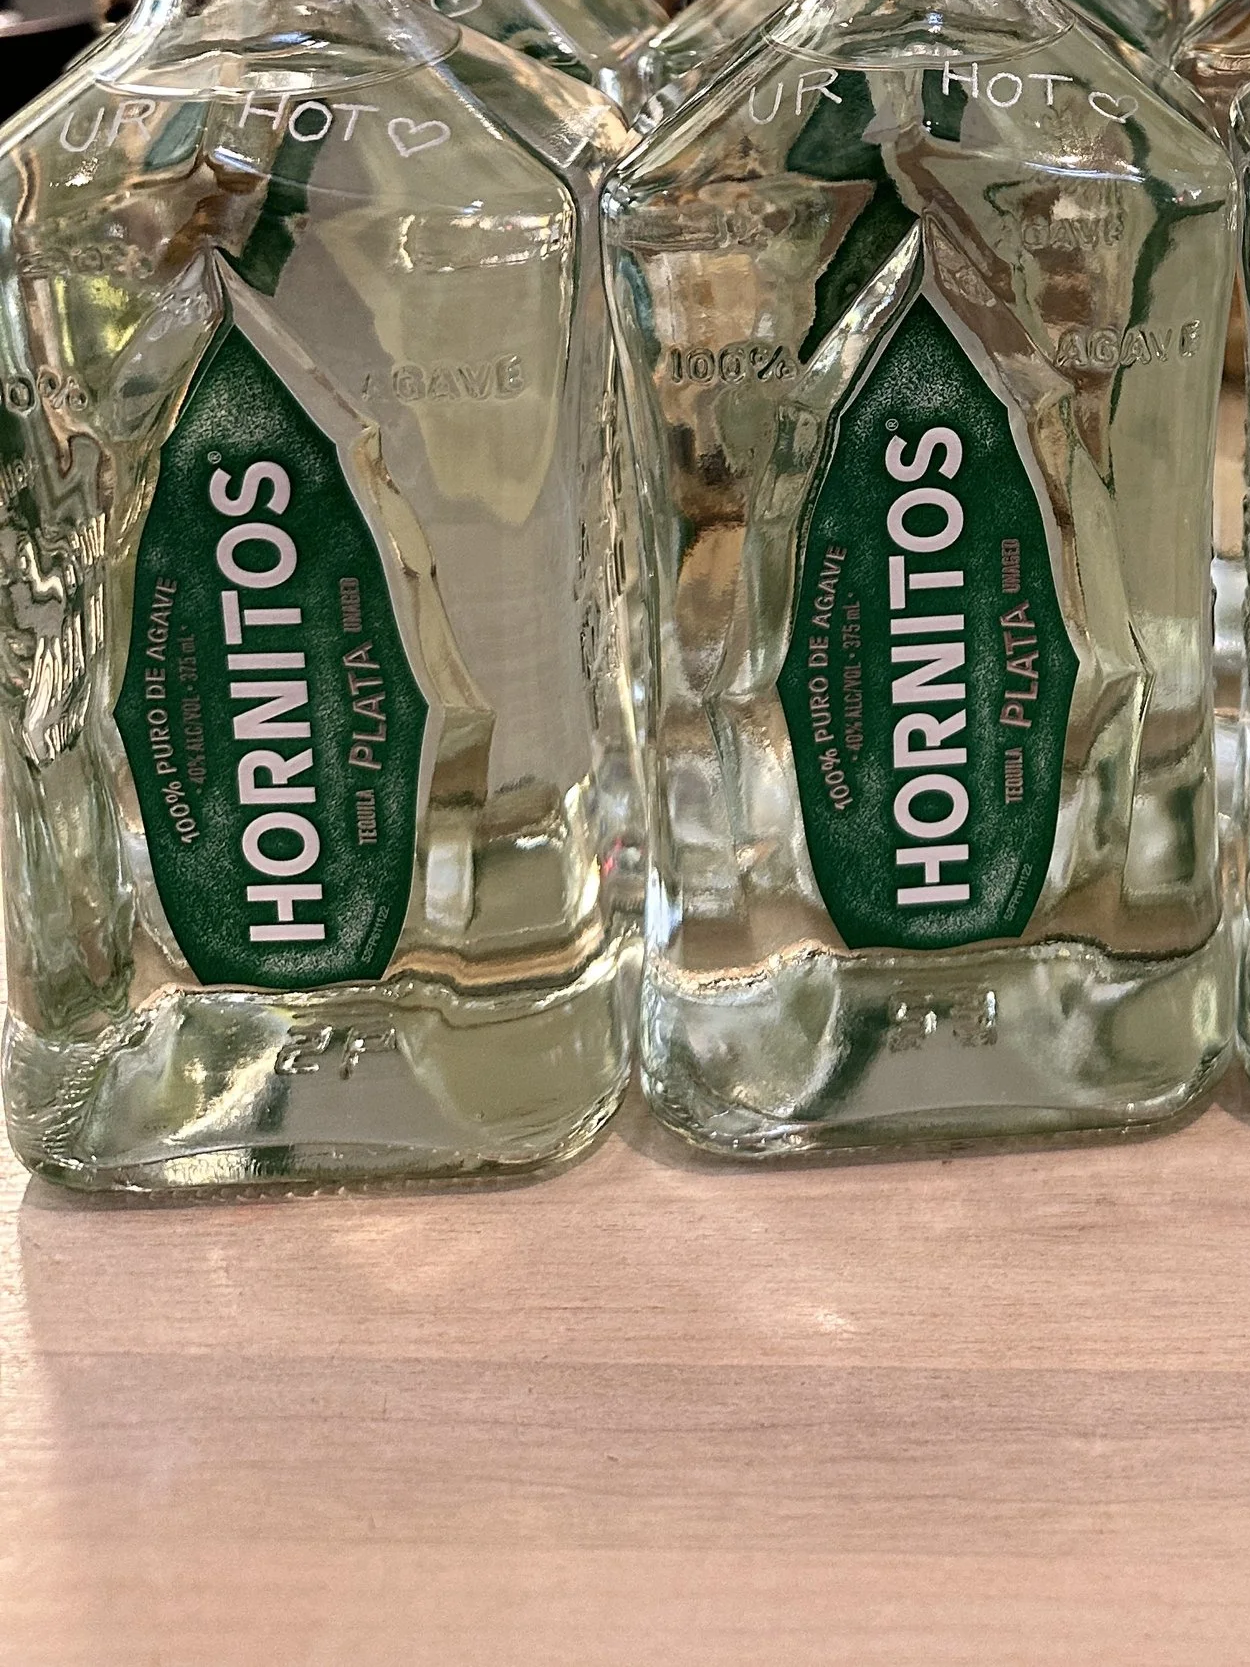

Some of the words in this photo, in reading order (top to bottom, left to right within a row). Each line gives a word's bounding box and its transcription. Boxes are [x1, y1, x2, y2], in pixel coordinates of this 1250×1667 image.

[60, 97, 155, 153] UR
[238, 91, 379, 142] HOT
[748, 68, 842, 126] UR
[942, 60, 1073, 108] HOT
[669, 345, 798, 384] 100%
[811, 544, 848, 629] AGAVE
[1002, 537, 1021, 594] UNAGED
[146, 577, 178, 663] AGAVE
[338, 576, 362, 633] UNAGED
[808, 636, 829, 668] DE
[842, 624, 861, 649] 375
[999, 599, 1040, 729] PLATA
[145, 668, 166, 700] DE
[342, 641, 387, 771] PLATA
[809, 675, 836, 744] PURO
[843, 665, 863, 723] ALC/VOL
[145, 708, 178, 775] PURO
[846, 724, 864, 751] 40%
[819, 748, 853, 811] 100%
[1004, 745, 1025, 806] TEQUILA
[161, 781, 200, 845] 100%
[356, 788, 378, 846] TEQUILA
